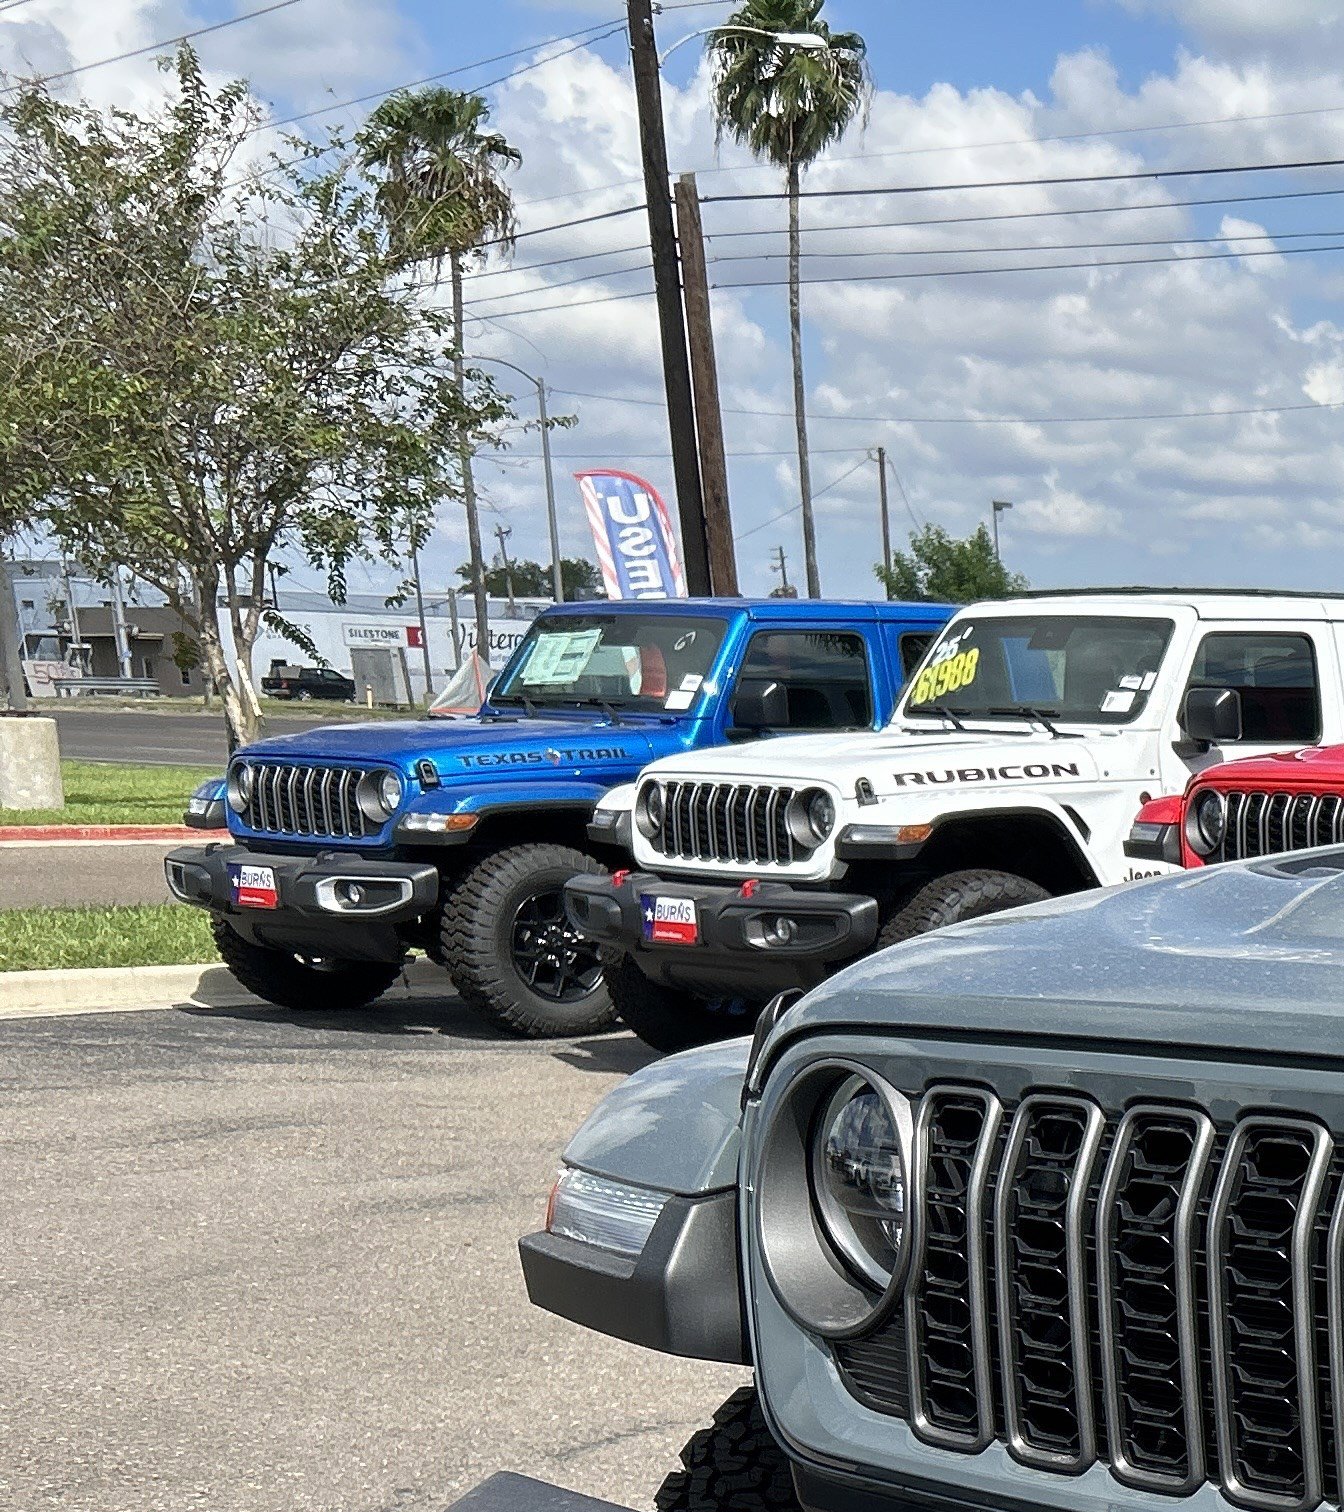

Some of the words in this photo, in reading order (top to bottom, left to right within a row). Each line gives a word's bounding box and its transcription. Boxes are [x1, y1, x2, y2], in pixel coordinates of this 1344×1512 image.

[348, 628, 399, 640] SILESTONE
[914, 647, 979, 705] 61988
[457, 752, 542, 768] TEXAS
[563, 749, 630, 761] TRAIL
[893, 763, 1079, 786] RUBICON
[241, 871, 272, 888] BURNS
[656, 903, 691, 922] BURNS
